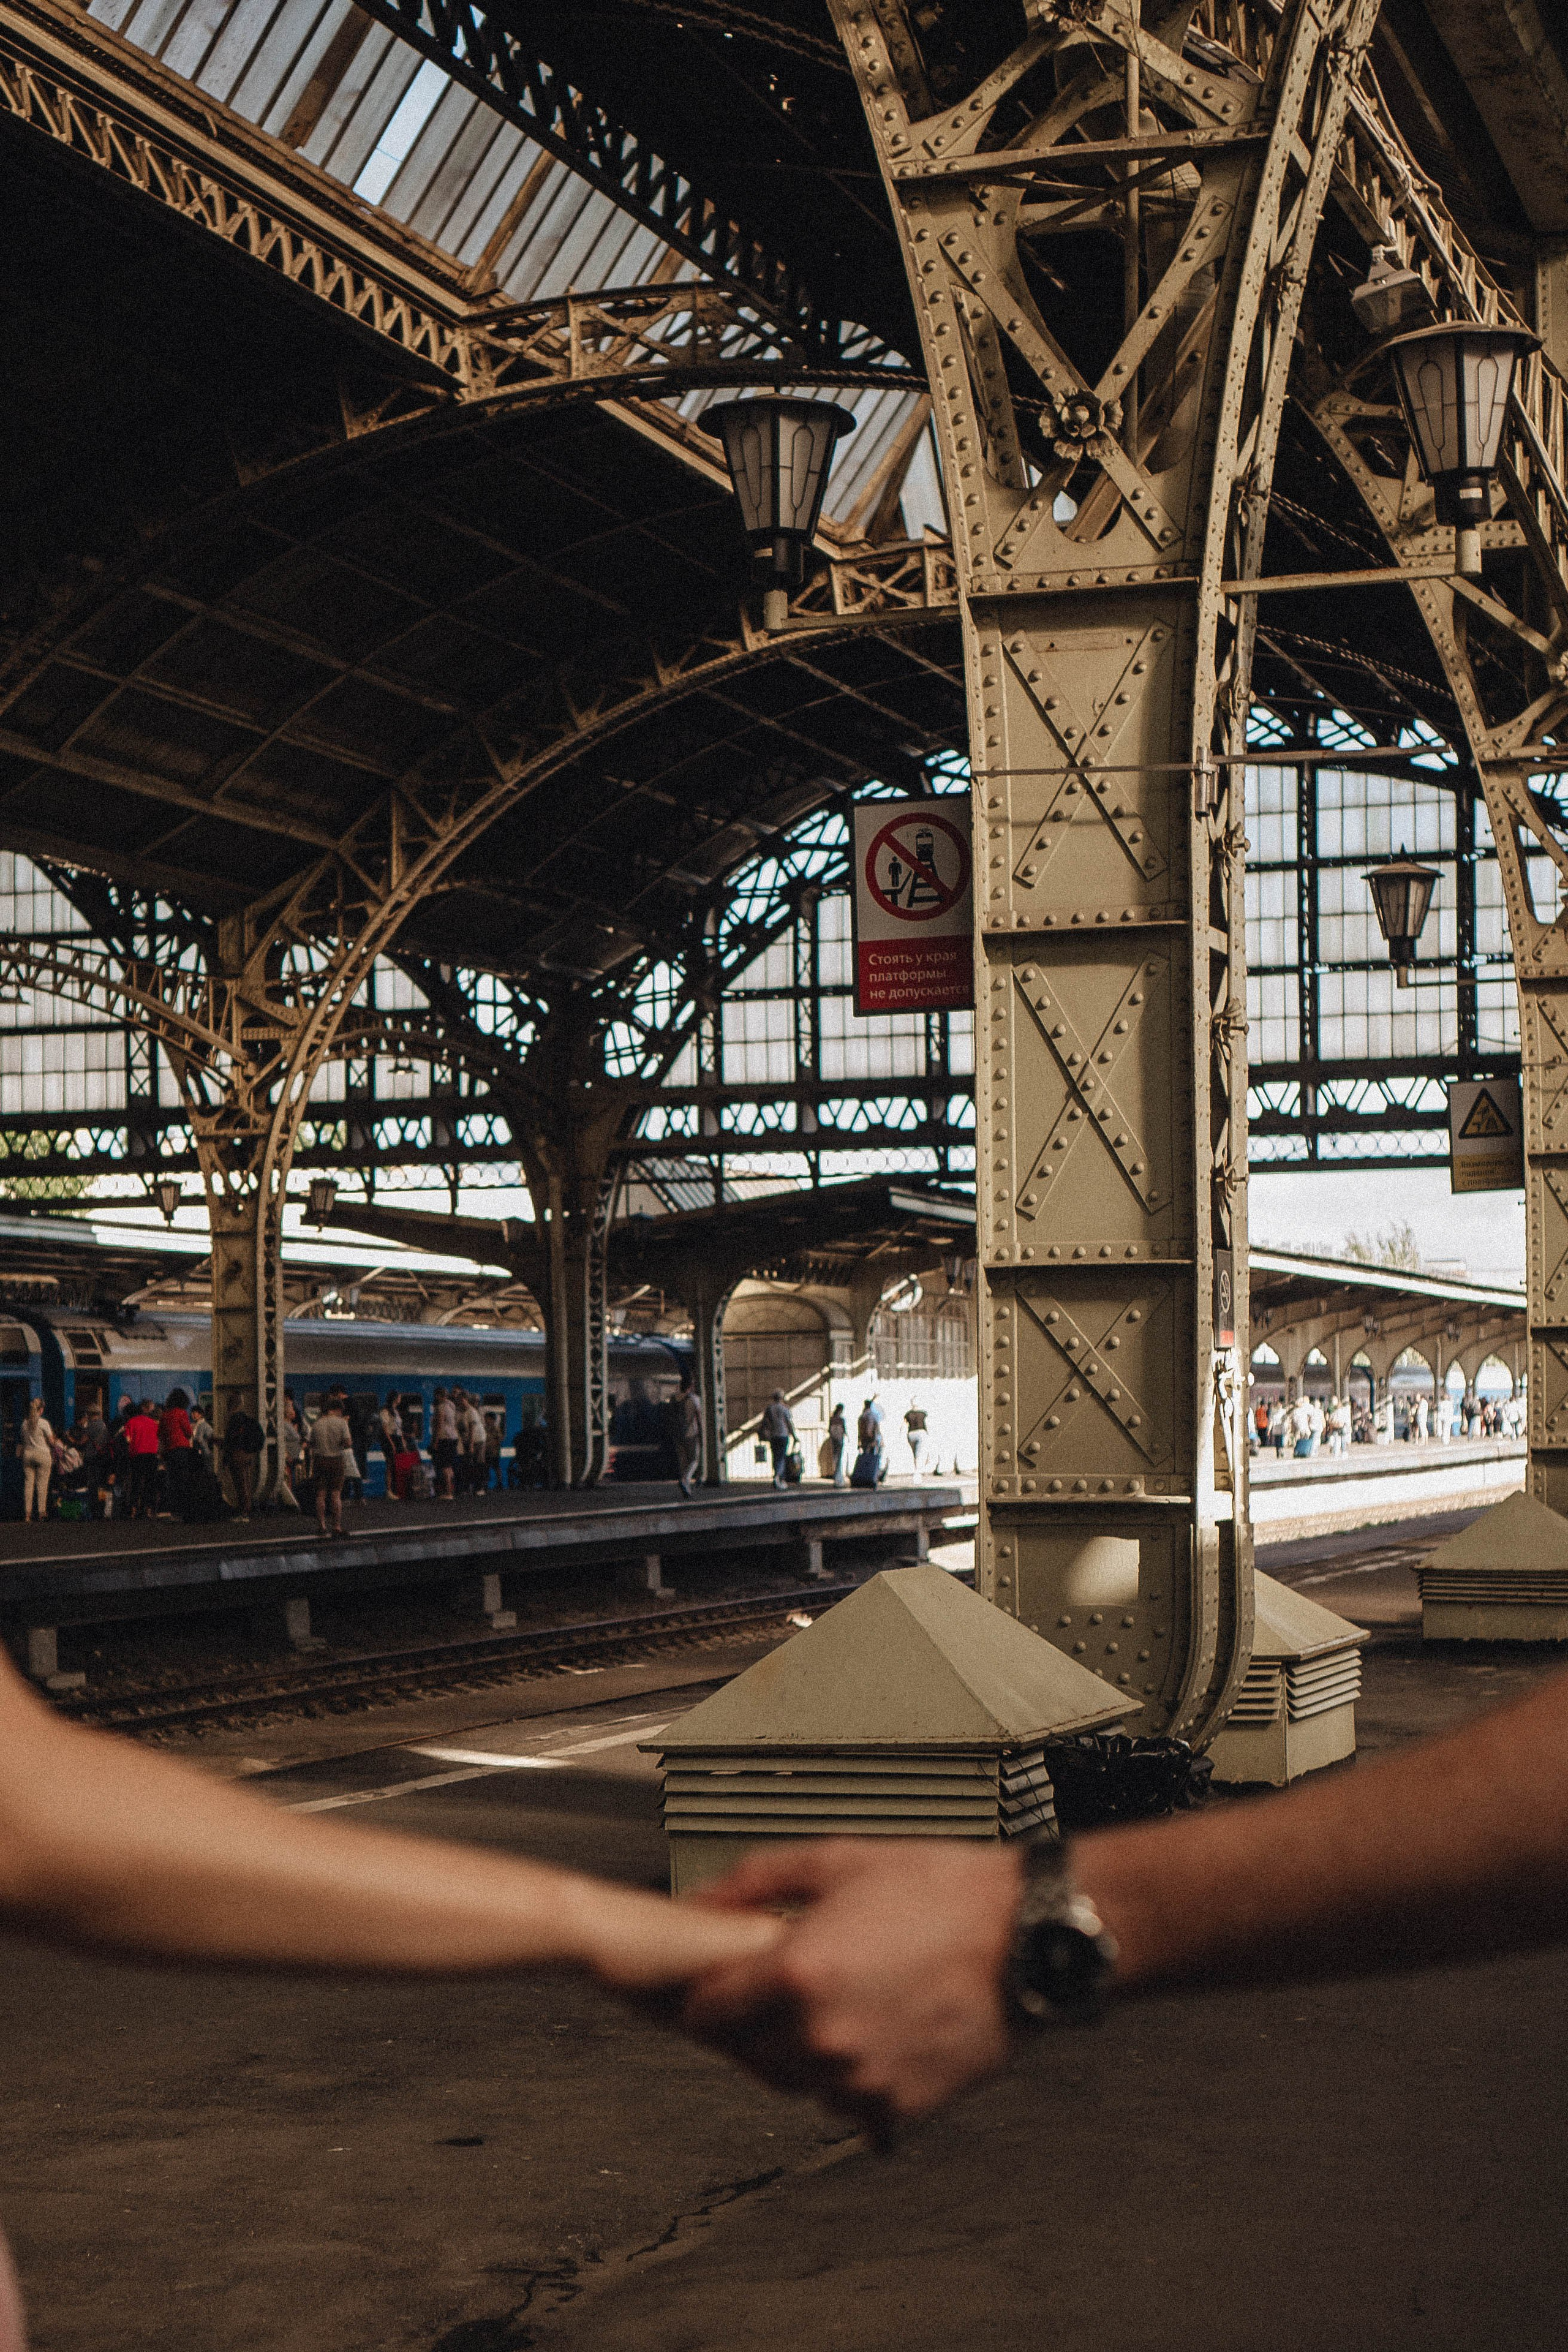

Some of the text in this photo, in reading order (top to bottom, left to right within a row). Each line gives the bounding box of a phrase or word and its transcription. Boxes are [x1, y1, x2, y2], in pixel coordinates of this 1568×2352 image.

[869, 952, 957, 966] Стоять у края
[869, 969, 946, 983] платформы
[870, 984, 969, 1000] не допускается
